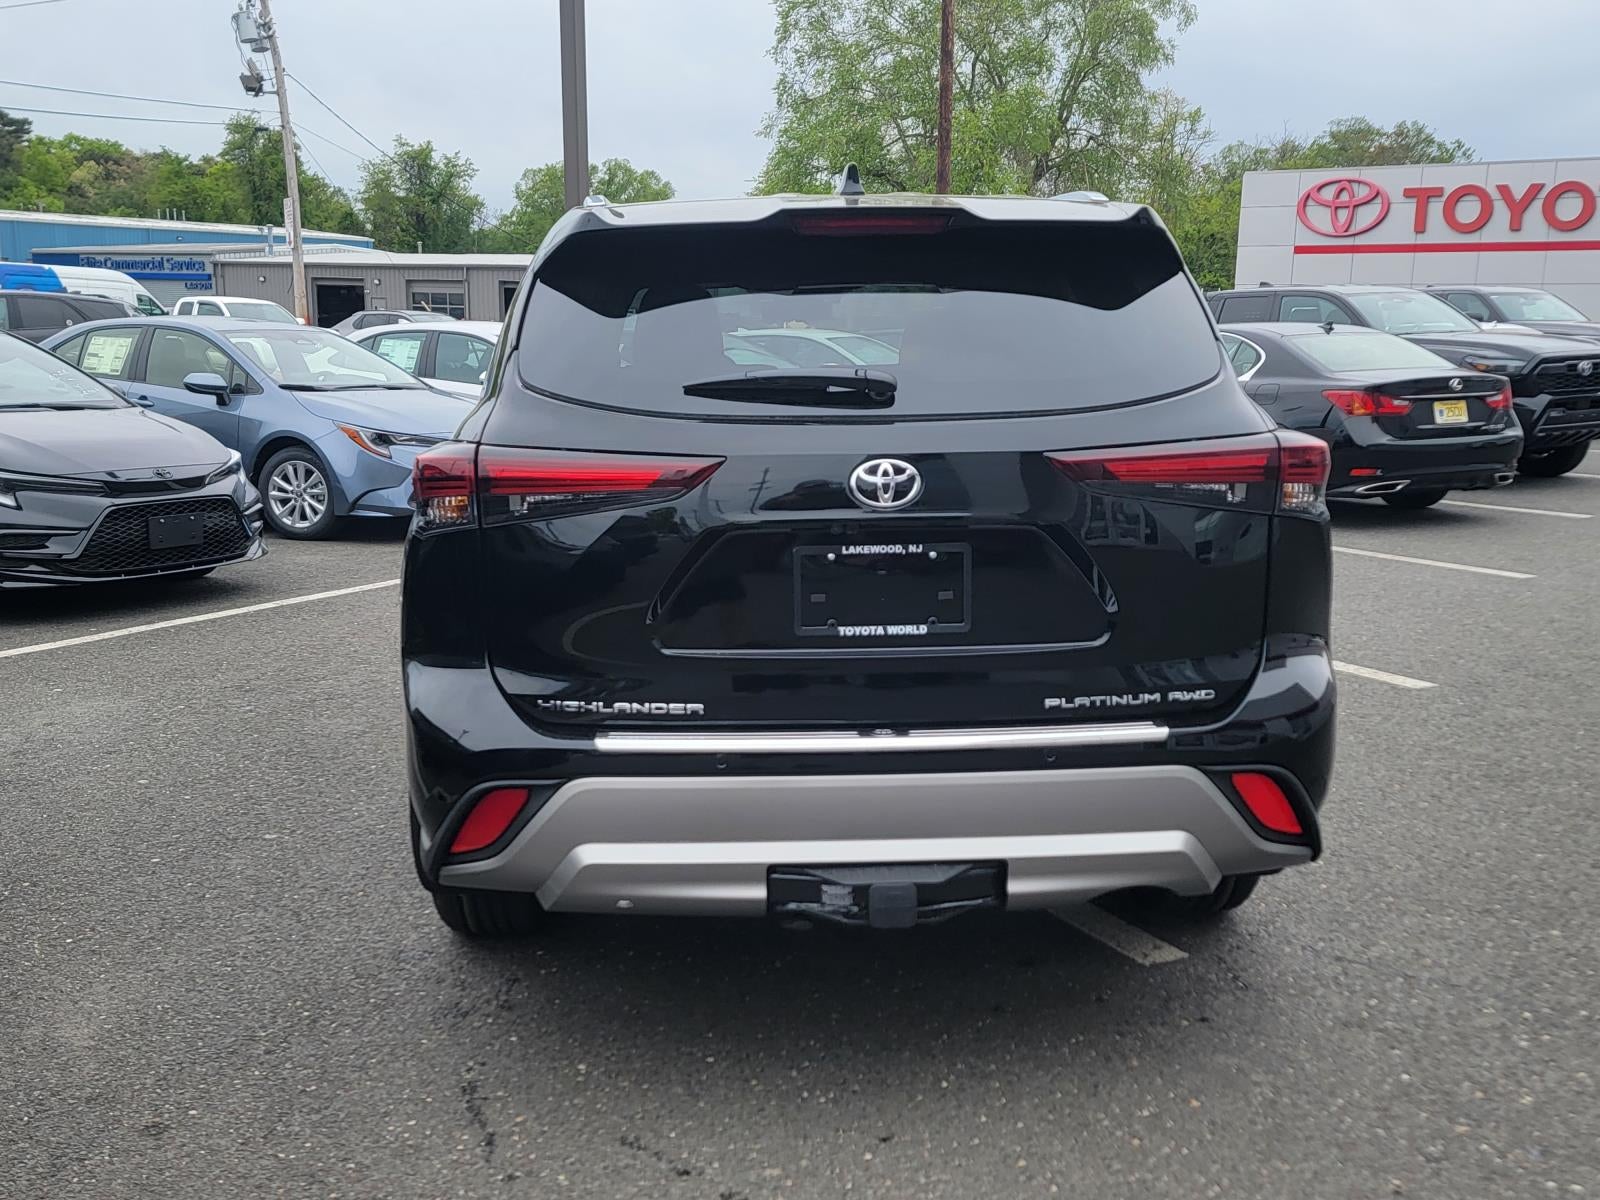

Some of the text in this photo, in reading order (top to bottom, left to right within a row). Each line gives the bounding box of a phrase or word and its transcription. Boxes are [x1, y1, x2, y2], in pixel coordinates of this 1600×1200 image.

[1403, 180, 1600, 234] TOYO
[104, 256, 165, 271] Commercial
[166, 257, 205, 271] Service
[841, 544, 923, 555] LAKEWOOD, NJ
[838, 624, 928, 636] TOYOTA WORLD
[1044, 689, 1216, 709] PLATINUM AWD
[537, 699, 705, 715] HIGHLANDER
